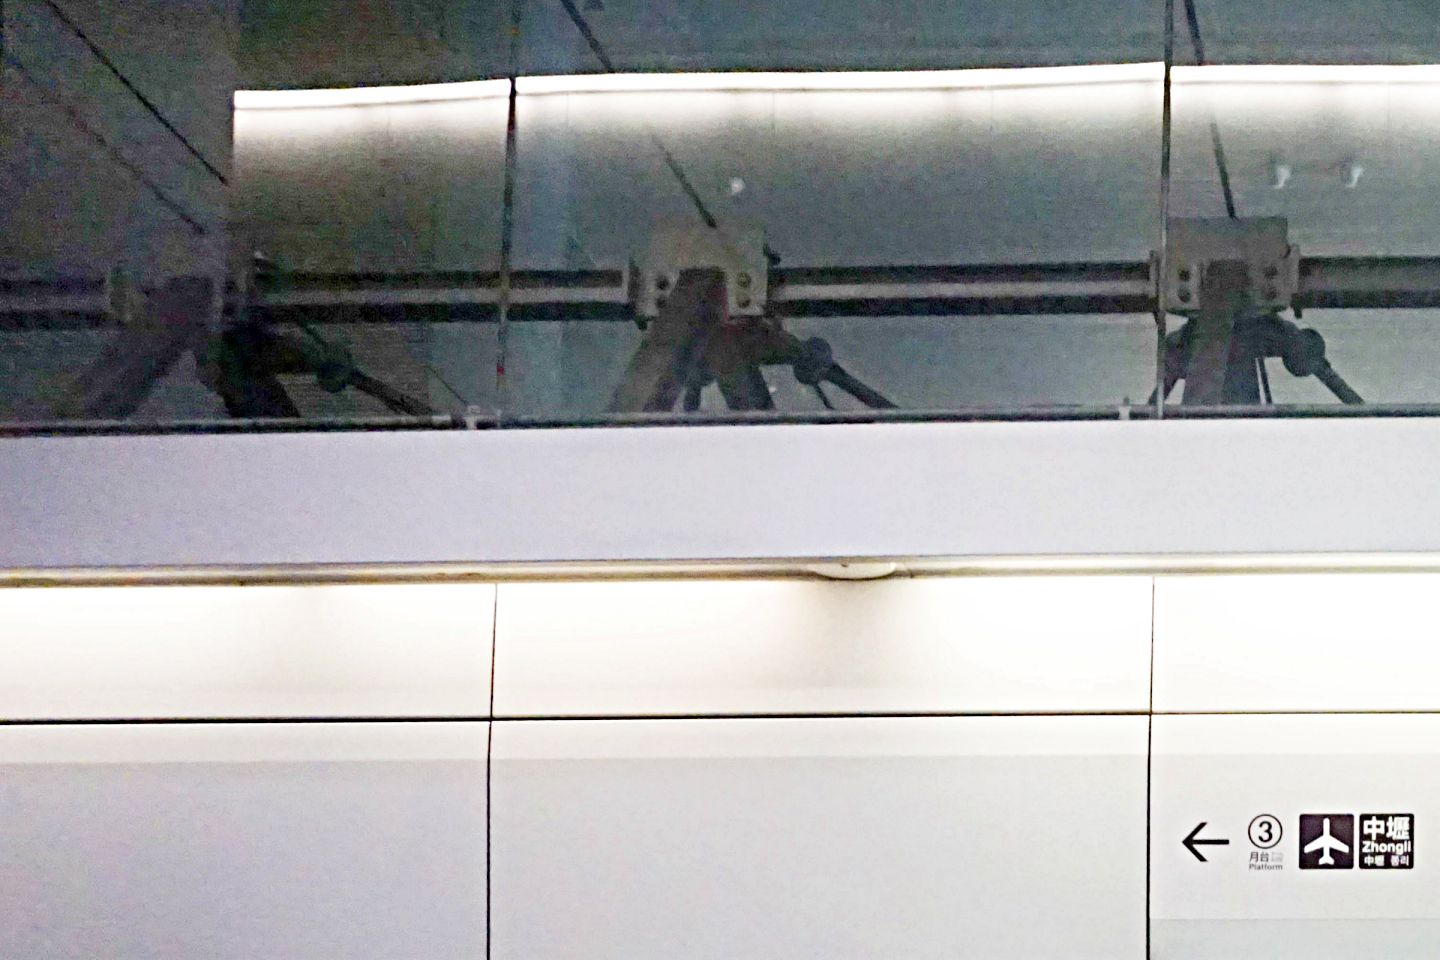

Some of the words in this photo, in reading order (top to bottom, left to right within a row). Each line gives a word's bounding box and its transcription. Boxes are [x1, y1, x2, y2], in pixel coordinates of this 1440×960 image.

[1362, 815, 1411, 841] 中壢
[1361, 840, 1412, 856] Zhongli
[1249, 851, 1269, 863] 月台
